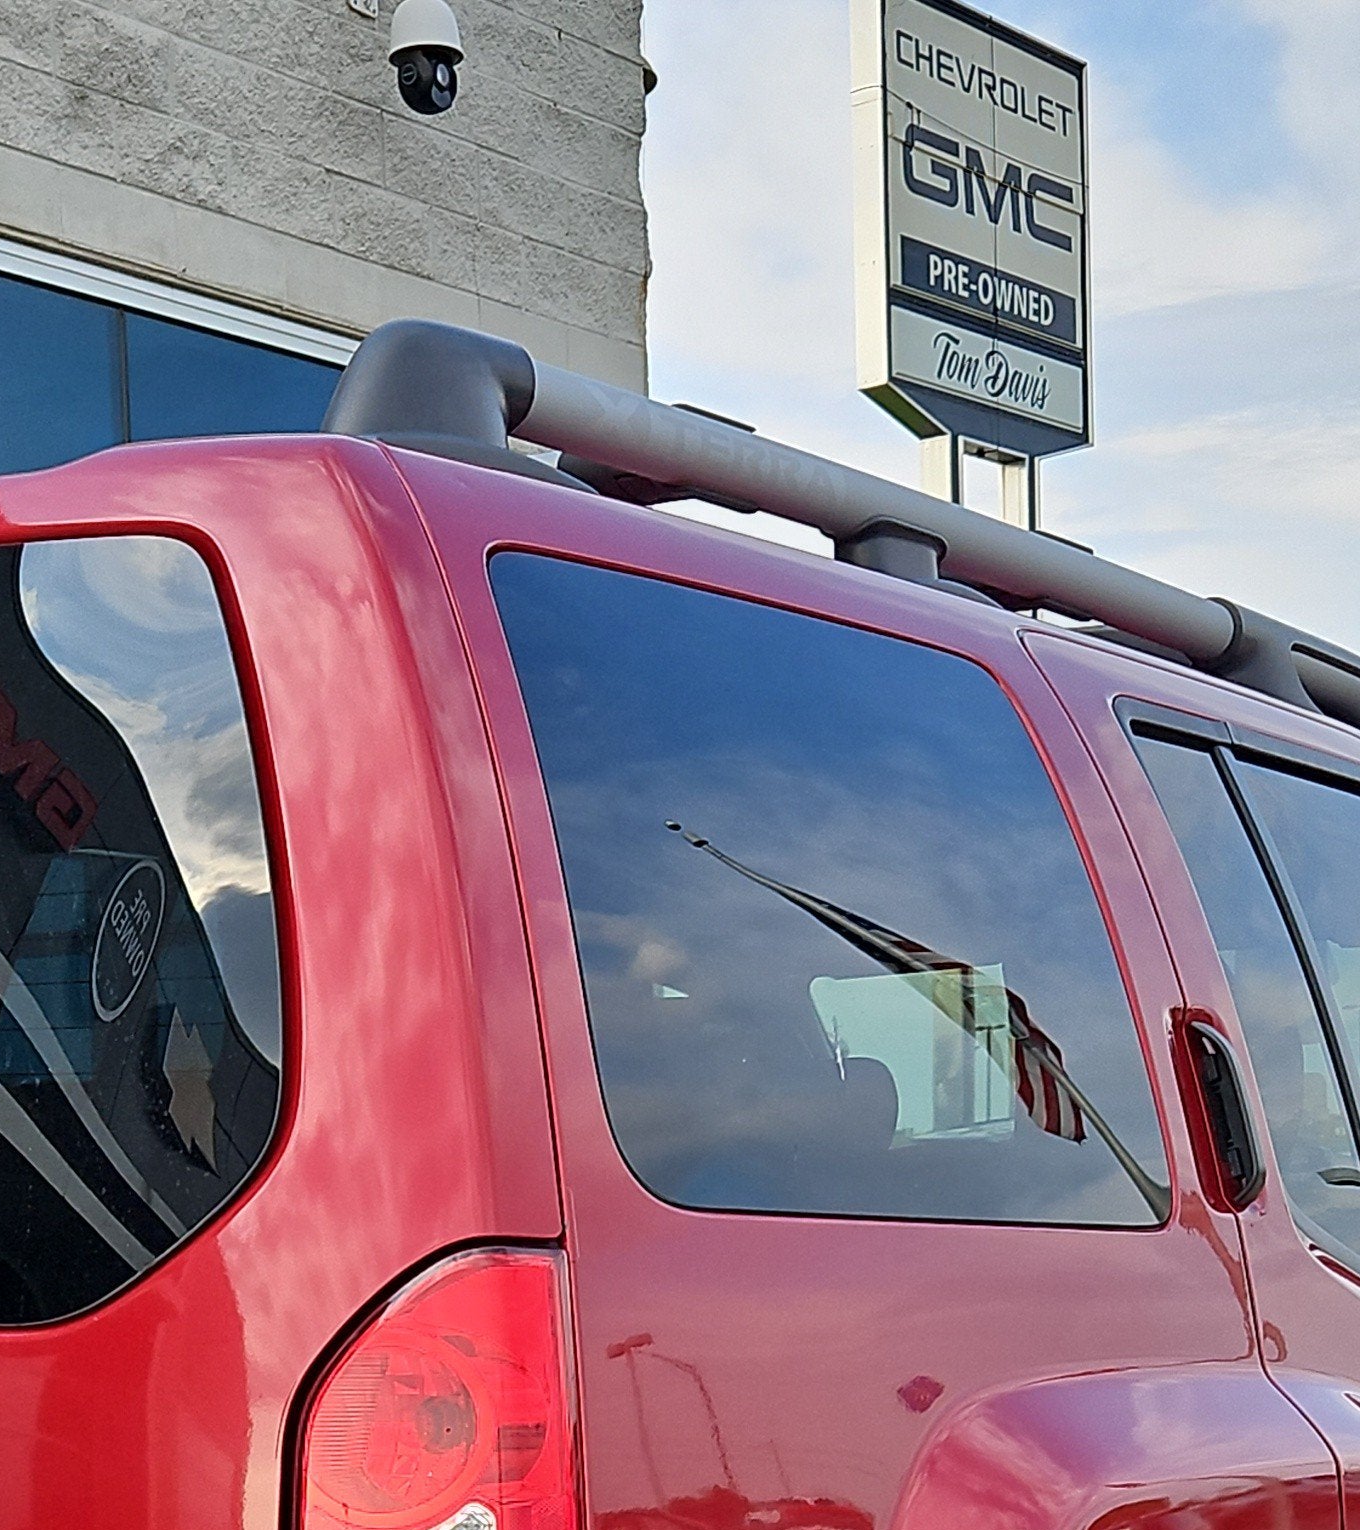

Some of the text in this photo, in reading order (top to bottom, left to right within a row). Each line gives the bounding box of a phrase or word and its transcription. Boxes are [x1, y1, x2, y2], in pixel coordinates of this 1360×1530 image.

[895, 29, 1074, 138] CHEVROLET
[903, 123, 1074, 253] GMC
[928, 253, 1054, 328] PRE-OWNED
[933, 332, 1051, 411] Tom Davis
